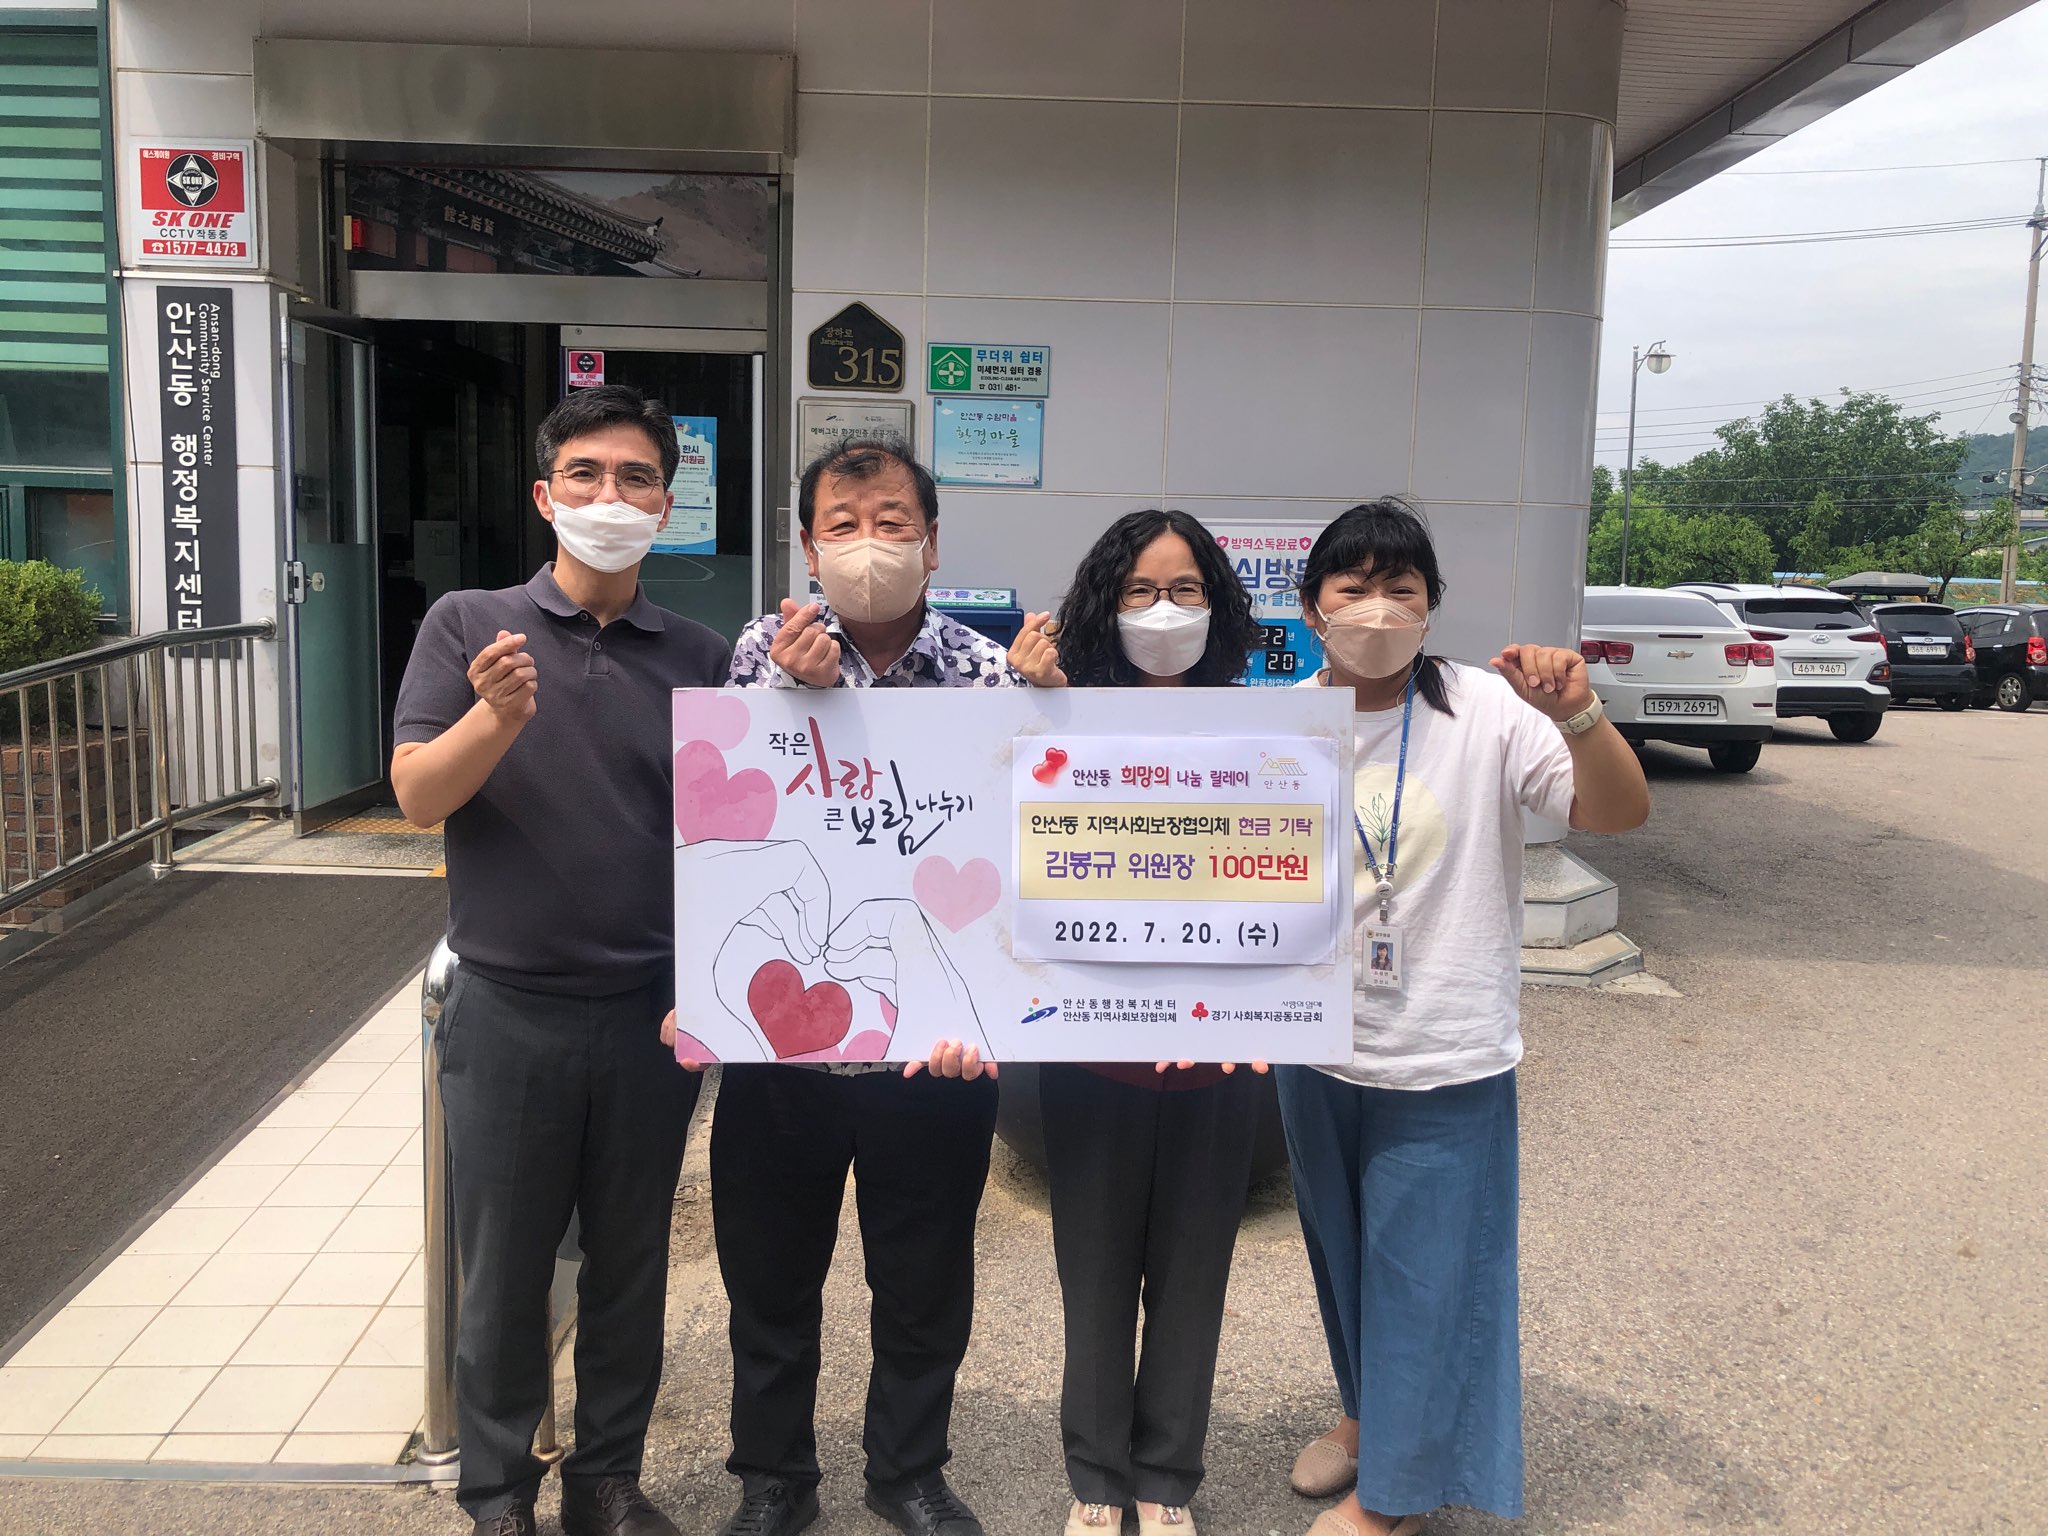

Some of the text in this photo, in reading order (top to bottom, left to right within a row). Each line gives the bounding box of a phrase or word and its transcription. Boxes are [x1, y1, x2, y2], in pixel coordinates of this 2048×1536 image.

[212, 152, 240, 161] 경비구역
[152, 211, 235, 228] SK ONE
[165, 241, 238, 256] 1577-4473
[210, 303, 222, 379] Ansan-dong
[166, 302, 198, 406] 안산동
[976, 349, 1043, 364] 무더위 쉼터
[834, 346, 901, 385] 315
[977, 365, 1042, 376] 미세먼지 쉼터 겸용
[199, 303, 213, 467] Community Service Center
[961, 412, 984, 421] 안산동
[170, 433, 202, 631] 행정복지센터
[1231, 537, 1298, 550] 방역소독완료
[1268, 653, 1293, 670] 20
[1819, 664, 1841, 673] 9467
[1650, 700, 1712, 713] 159가 2691
[768, 716, 883, 801] 작은 사랑
[1072, 765, 1249, 788] 안산동 희망의 나눔 릴레이
[1264, 779, 1301, 791] 안산동
[823, 808, 845, 831] 큰
[915, 790, 974, 822] 나누기
[1031, 815, 1313, 837] 안산동 지역사회보장협의체 현금 기탁
[1045, 851, 1309, 881] 김봉규 위원장 100만원
[1055, 920, 1279, 948] 2022. 7. 20. (수)
[1062, 1011, 1177, 1023] 안산동 지역사회보장협의체
[1211, 1010, 1323, 1023] 경기 사회복지공동모금회
